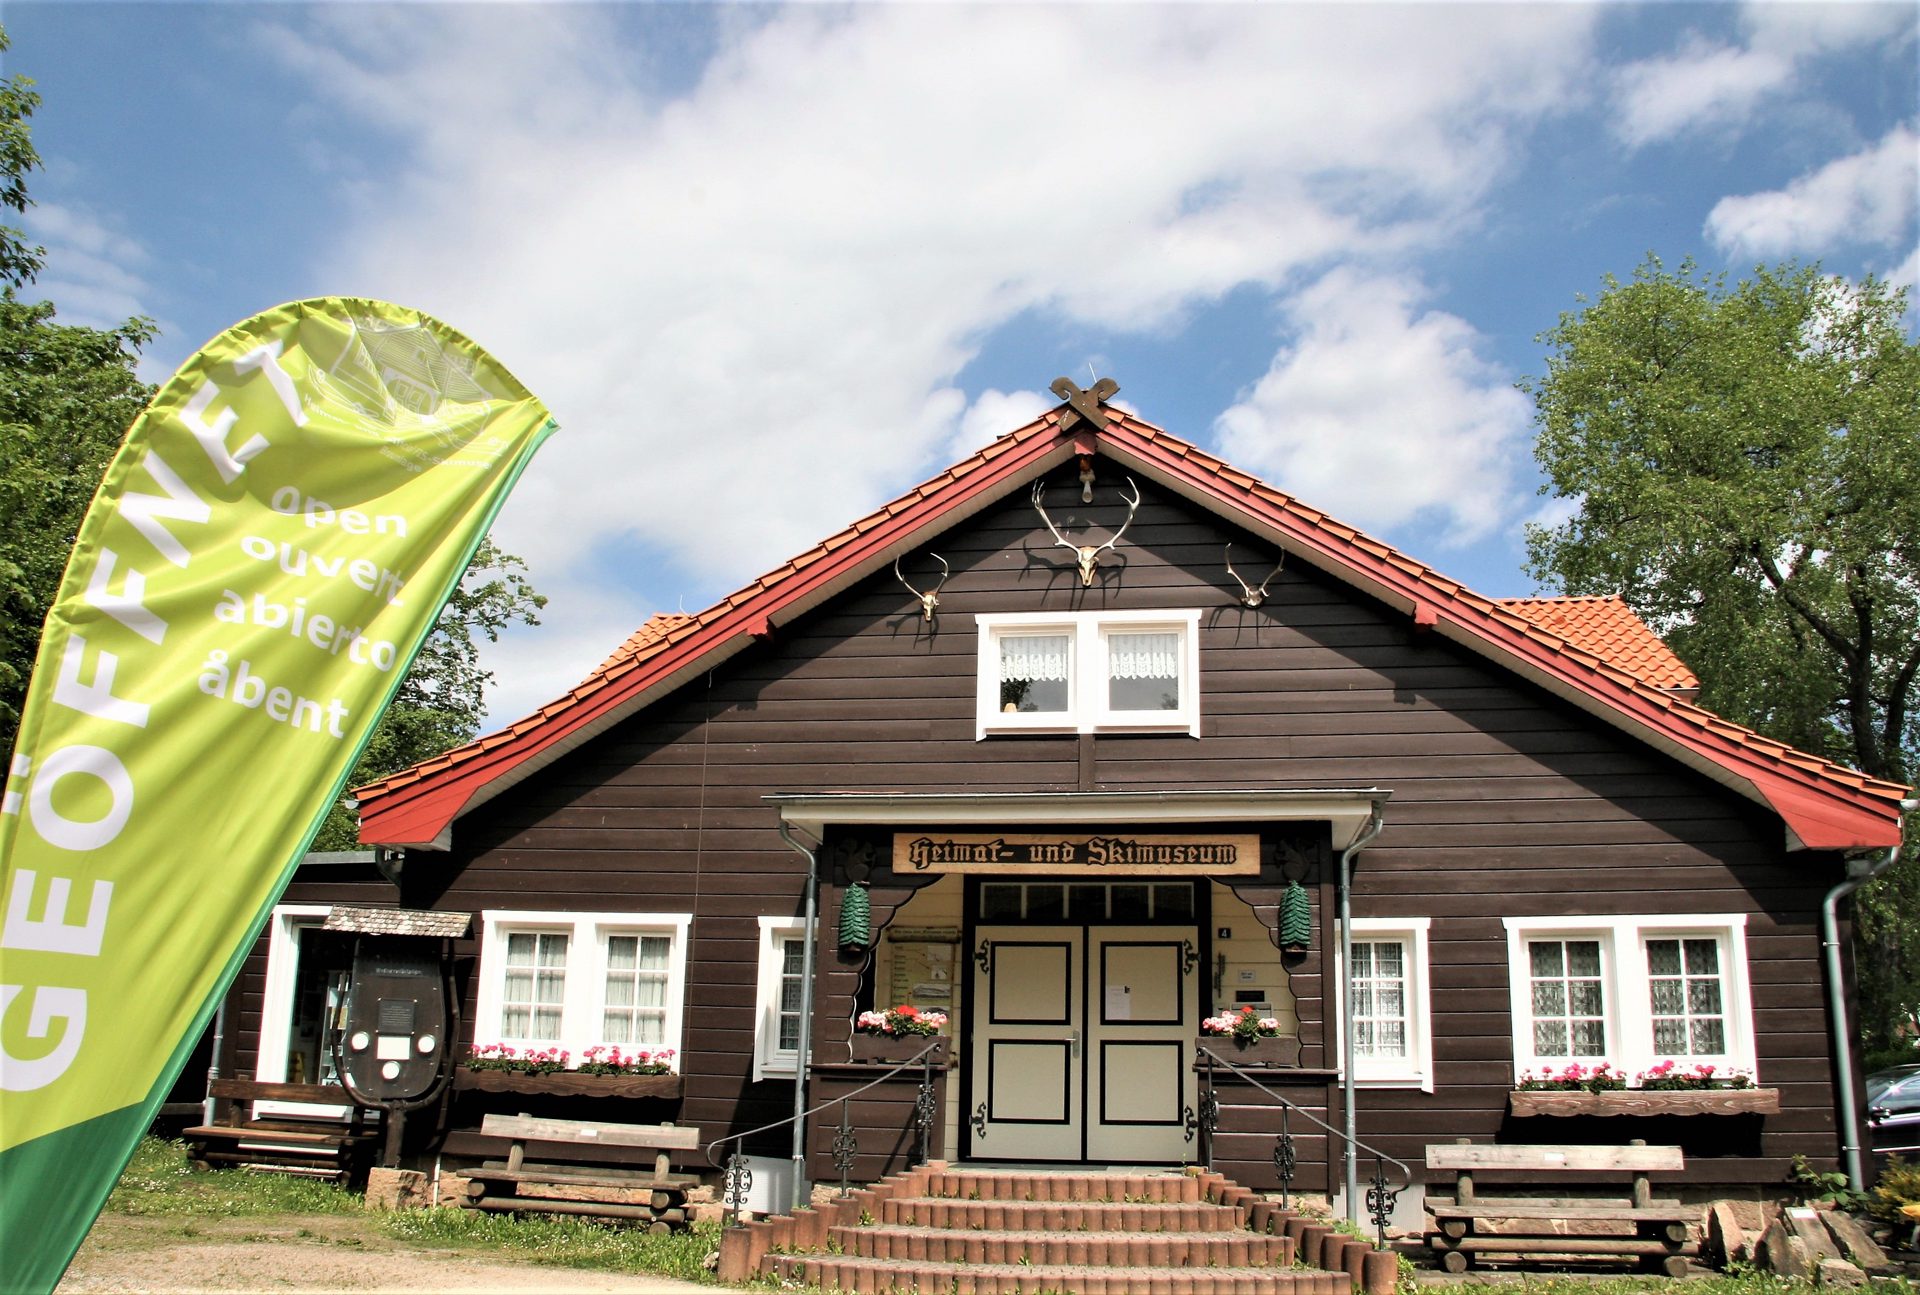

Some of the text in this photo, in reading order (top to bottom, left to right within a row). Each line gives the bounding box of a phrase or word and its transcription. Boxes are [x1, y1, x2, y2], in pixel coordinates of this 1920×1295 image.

[271, 486, 408, 538] open
[240, 536, 404, 607] ouvert
[214, 589, 397, 672] abierto
[0, 339, 309, 1091] GEÖFFNET
[198, 648, 349, 739] åbent
[909, 836, 1237, 869] Heimat- und Skimuseum
[1221, 928, 1228, 938] 4
